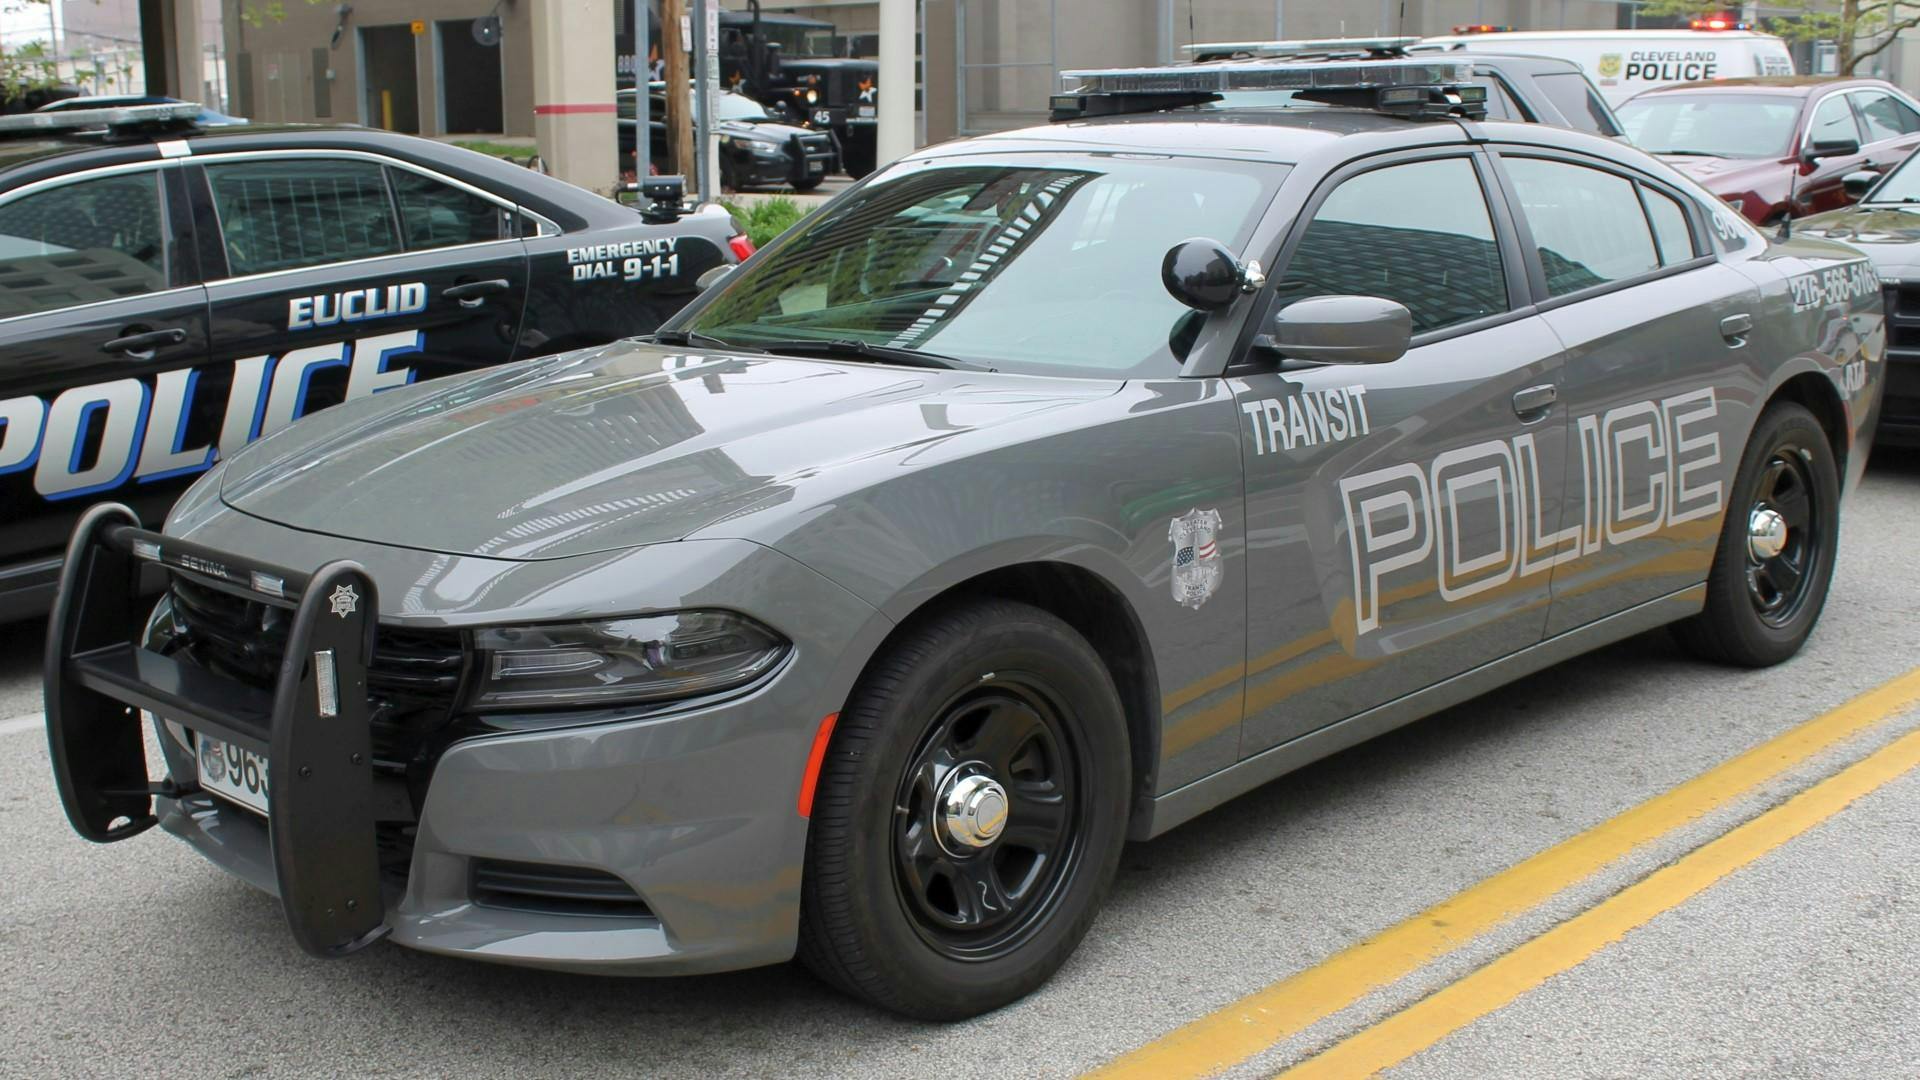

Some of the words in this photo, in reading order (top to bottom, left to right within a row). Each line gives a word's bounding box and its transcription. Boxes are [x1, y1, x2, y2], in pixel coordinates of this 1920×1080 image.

[1631, 51, 1717, 62] CLEVELAND
[1625, 63, 1717, 80] POLICE
[814, 110, 831, 124] 45
[567, 238, 677, 264] EMERGENCY
[573, 261, 618, 281] DIAL
[623, 254, 679, 281] 9-1-1
[288, 282, 428, 330] EUCLID
[1242, 384, 1369, 456] TRANSIT
[1340, 387, 1722, 635] POLICE
[182, 554, 231, 578] SETINA
